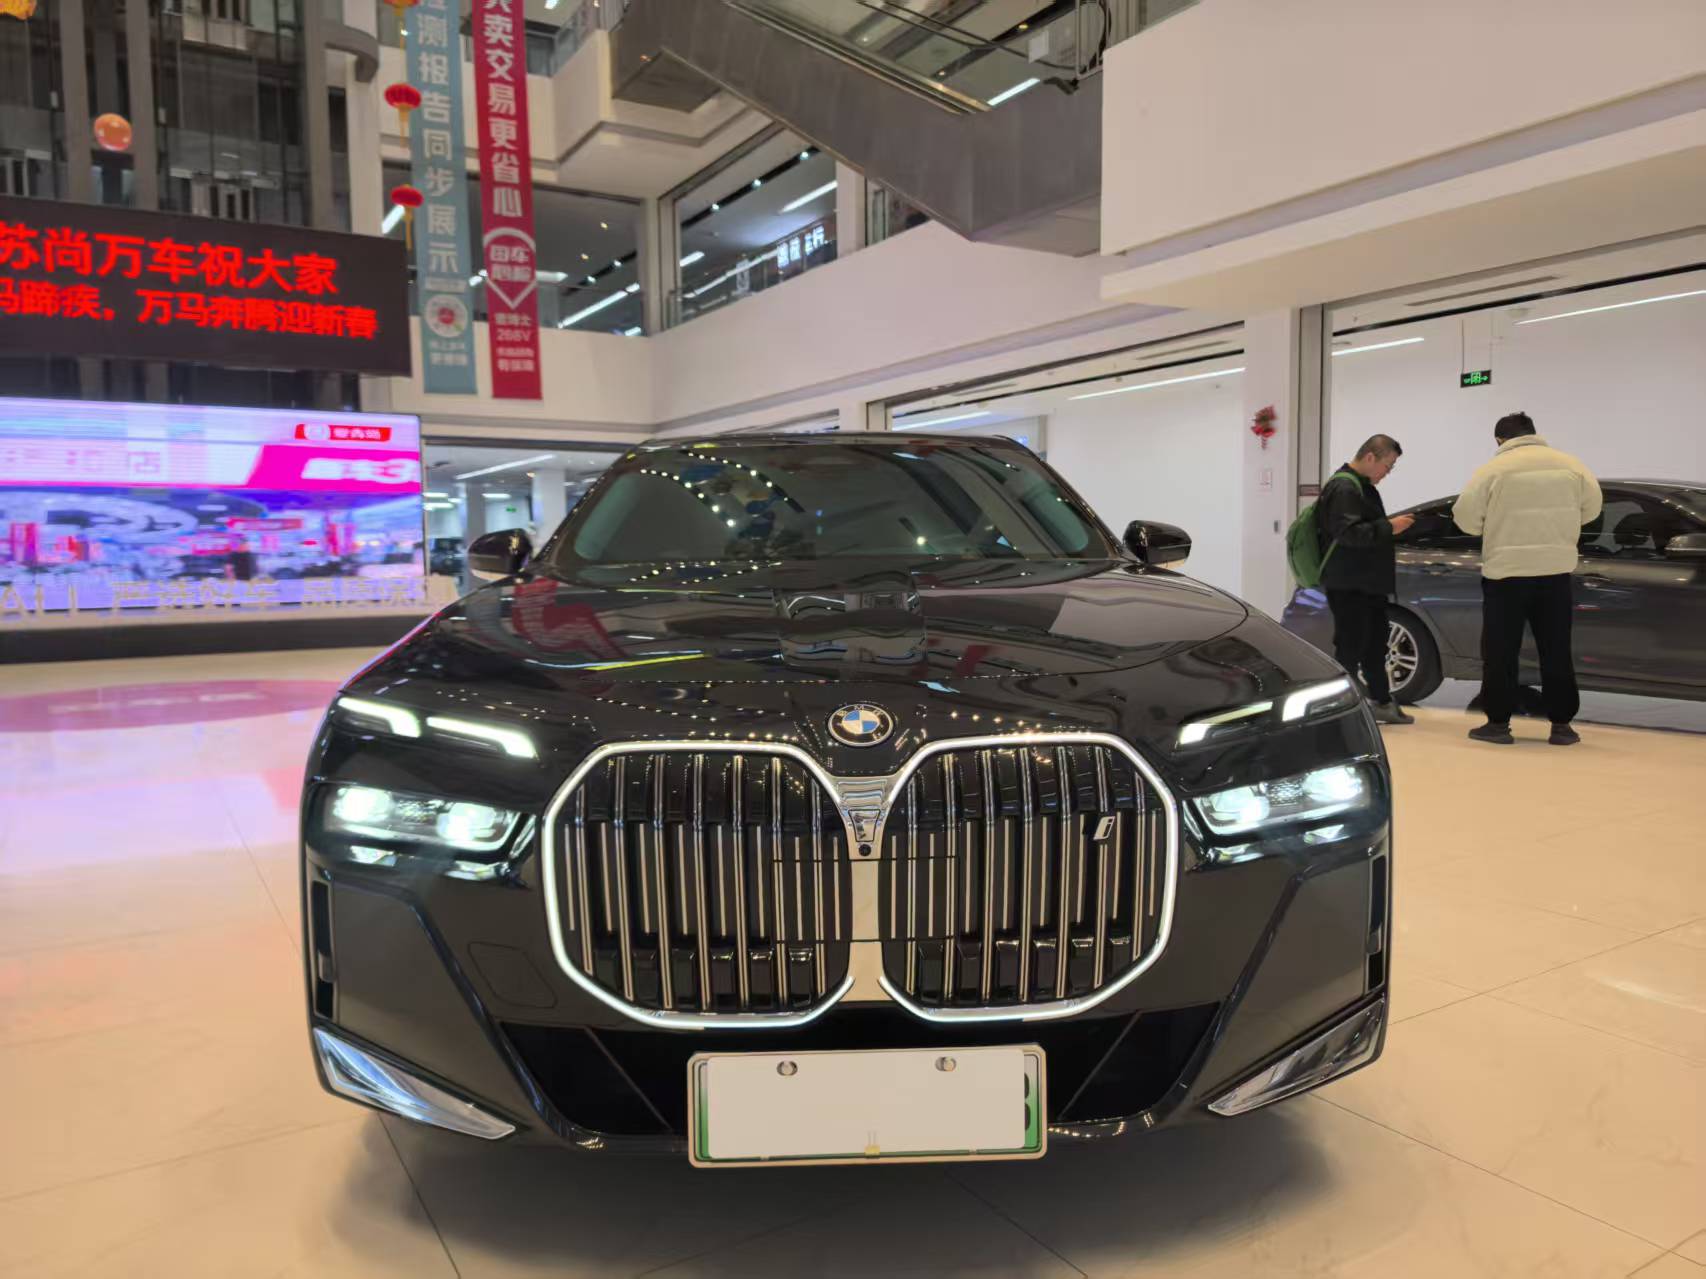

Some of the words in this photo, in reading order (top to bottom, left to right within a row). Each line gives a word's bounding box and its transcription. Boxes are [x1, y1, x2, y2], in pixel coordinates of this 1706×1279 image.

[0, 220, 339, 295] 苏尚万车祝大家
